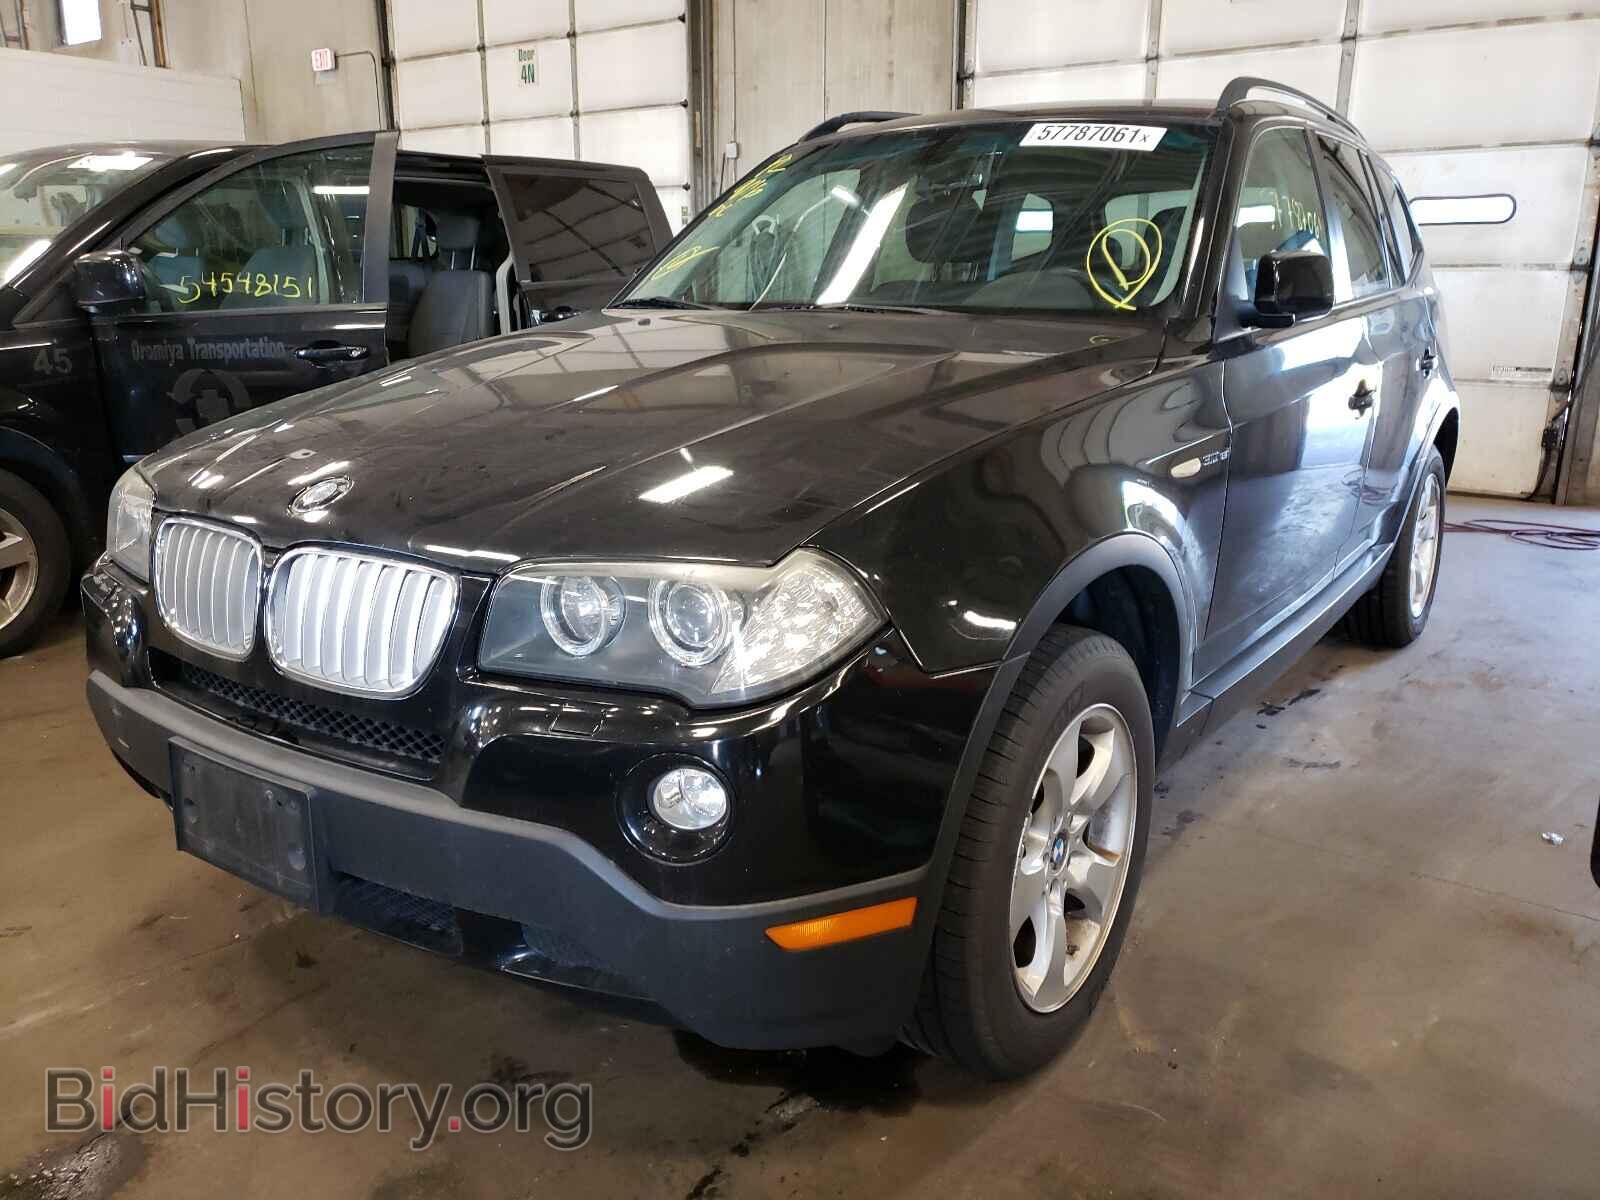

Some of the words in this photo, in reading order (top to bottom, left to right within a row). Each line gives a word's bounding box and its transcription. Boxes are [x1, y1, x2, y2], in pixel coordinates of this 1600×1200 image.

[521, 63, 535, 84] 4N
[177, 272, 313, 303] 54548151
[33, 348, 73, 375] 45
[187, 336, 286, 365] Transportation
